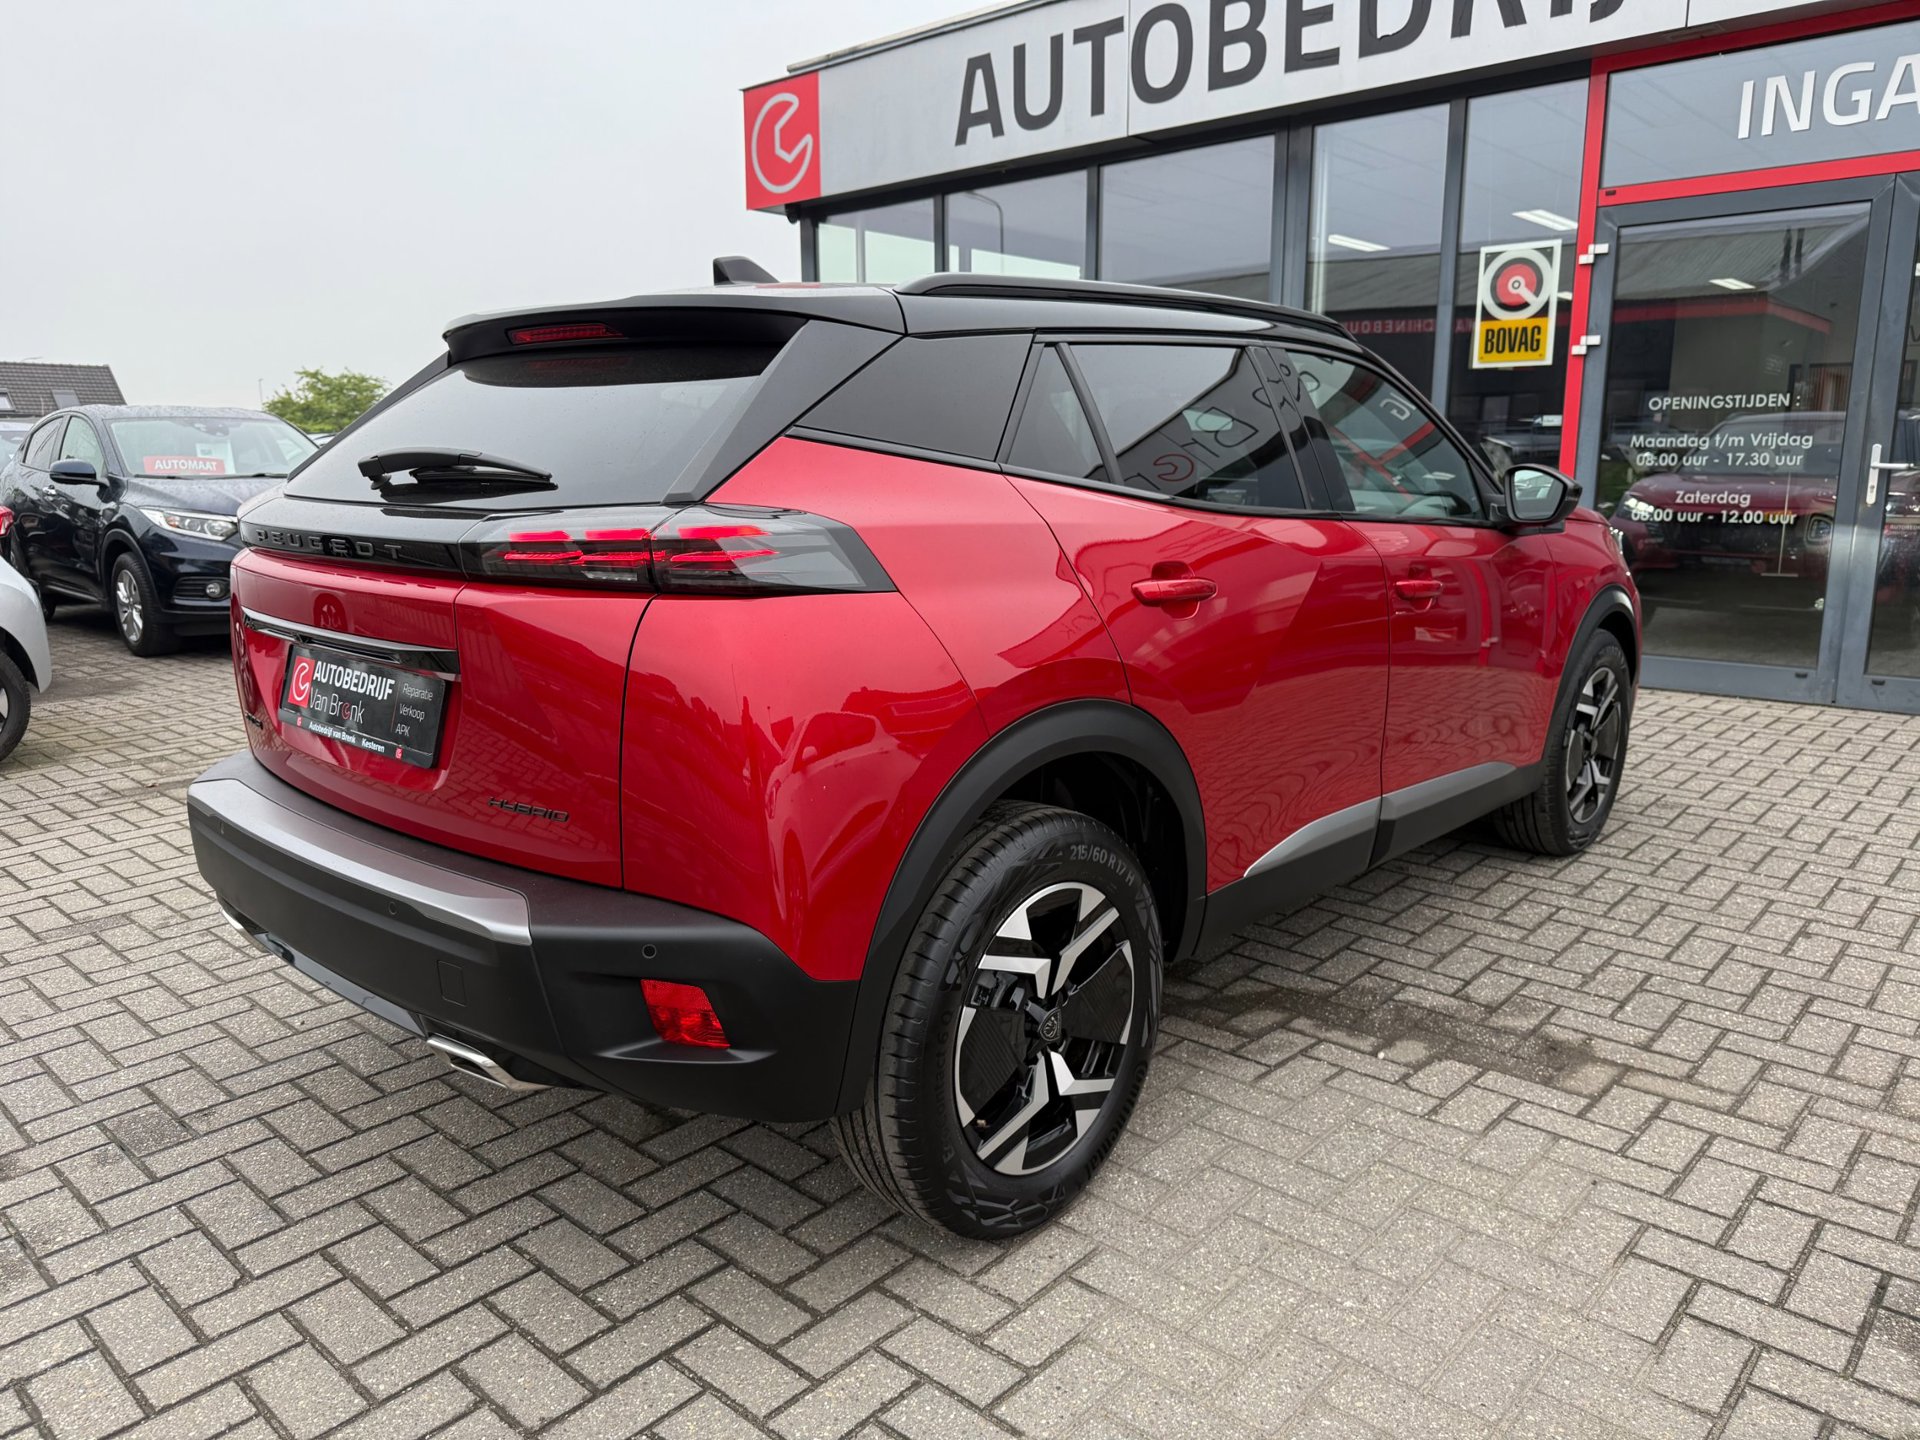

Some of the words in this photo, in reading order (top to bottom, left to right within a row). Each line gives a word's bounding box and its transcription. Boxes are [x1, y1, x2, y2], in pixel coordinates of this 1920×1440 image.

[1484, 325, 1541, 354] BOVAG
[1649, 393, 1790, 410] OPENINGSTIJDEN
[1630, 434, 1710, 449] Maandag
[1715, 433, 1744, 448] t/m
[1750, 432, 1814, 449] Vrijdag
[155, 459, 217, 471] AUTOMAAT
[1683, 455, 1709, 466] uur
[1727, 453, 1770, 466] 17.30
[1775, 454, 1803, 466] uur
[1675, 490, 1751, 506] Zaterdag
[1677, 511, 1703, 522] uur
[1721, 510, 1764, 524] 12.00
[1769, 511, 1797, 524] uur
[255, 529, 402, 560] PEUGEOT
[313, 660, 395, 700] AUTOBEDRIJF
[309, 687, 328, 713] Van
[402, 683, 434, 701] Reparatie
[399, 704, 425, 721] Verkoop
[308, 721, 334, 738] Autobedrijf
[342, 731, 356, 744] Brenk
[361, 738, 385, 753] Kesteren
[395, 723, 410, 737] APK
[488, 796, 569, 822] HYBRID
[1070, 845, 1107, 864] 215/60
